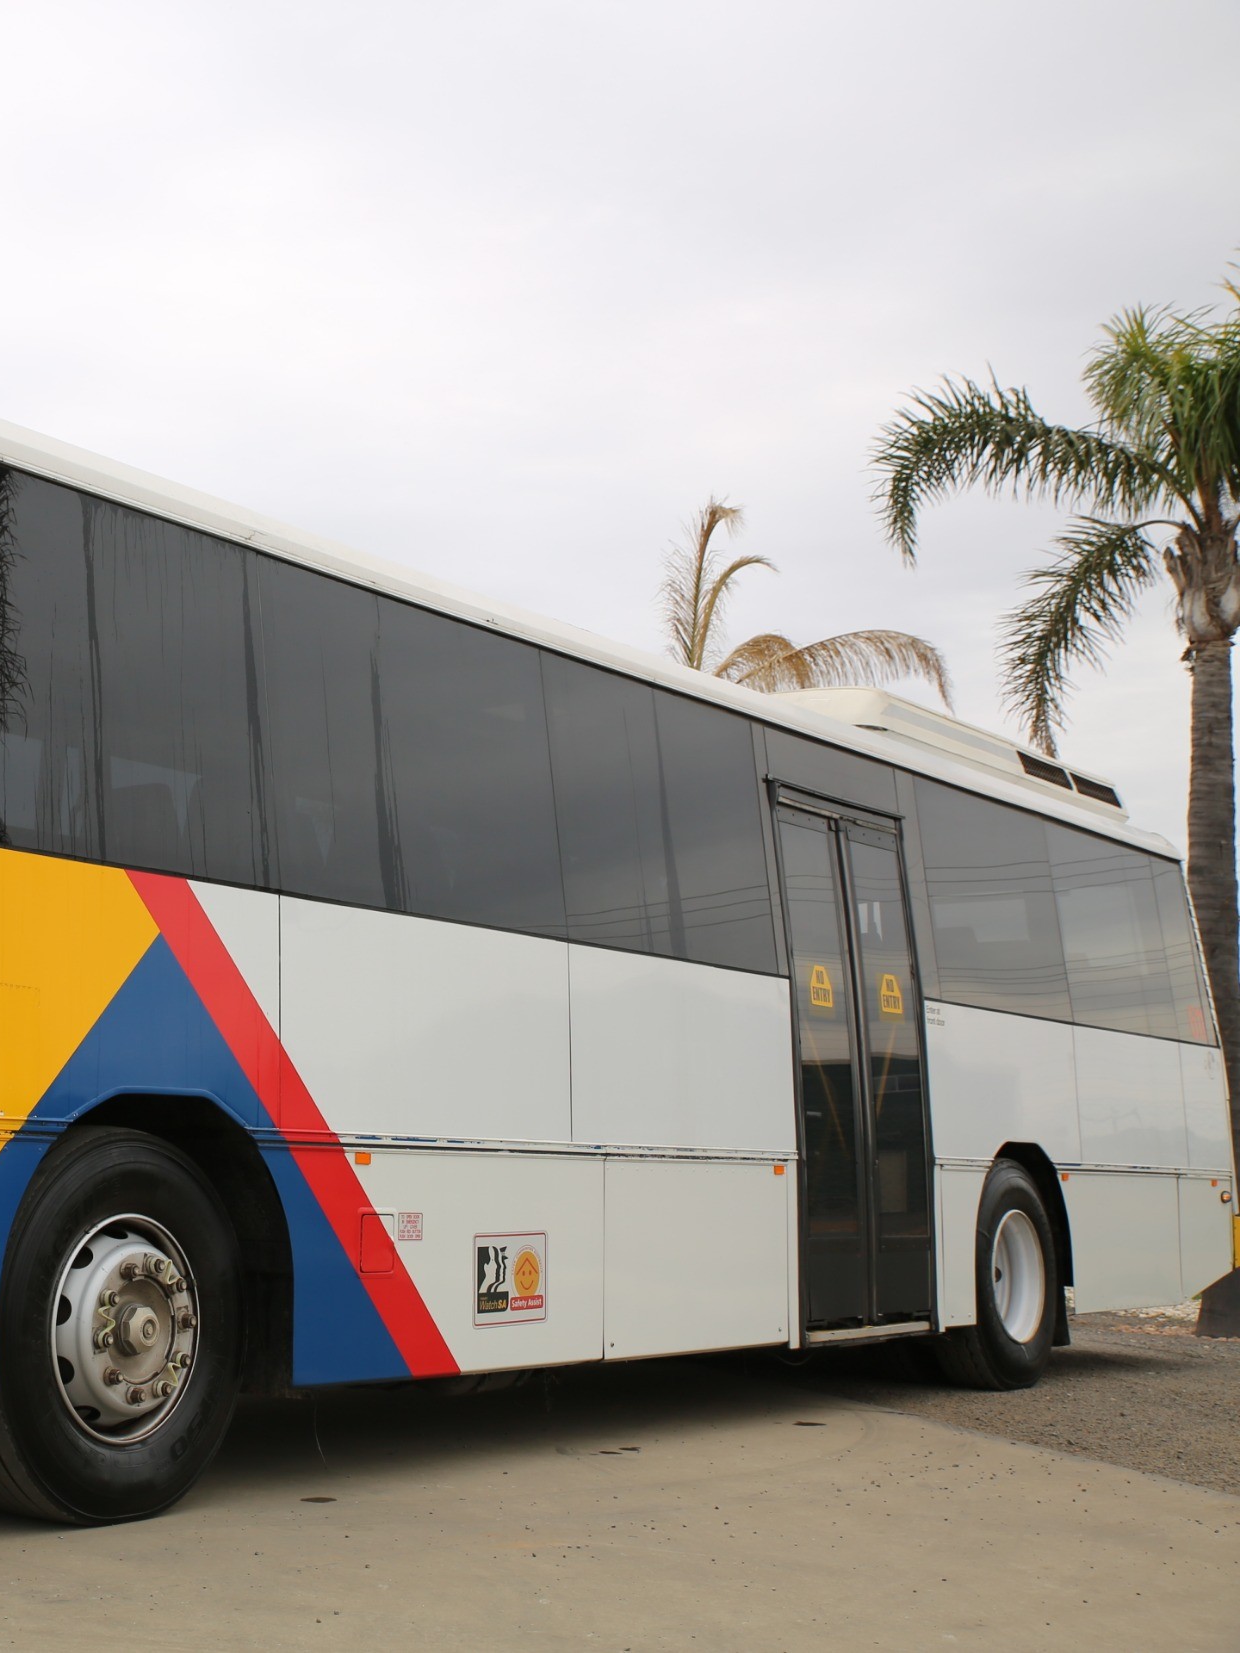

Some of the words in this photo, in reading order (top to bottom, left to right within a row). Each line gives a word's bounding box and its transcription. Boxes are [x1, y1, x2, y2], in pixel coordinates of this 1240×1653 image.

[815, 969, 825, 985] NO
[885, 978, 894, 993] NO
[812, 986, 831, 1003] ENTRY
[882, 994, 901, 1010] ENTRY
[511, 1299, 528, 1309] Safety
[528, 1298, 542, 1306] Assist
